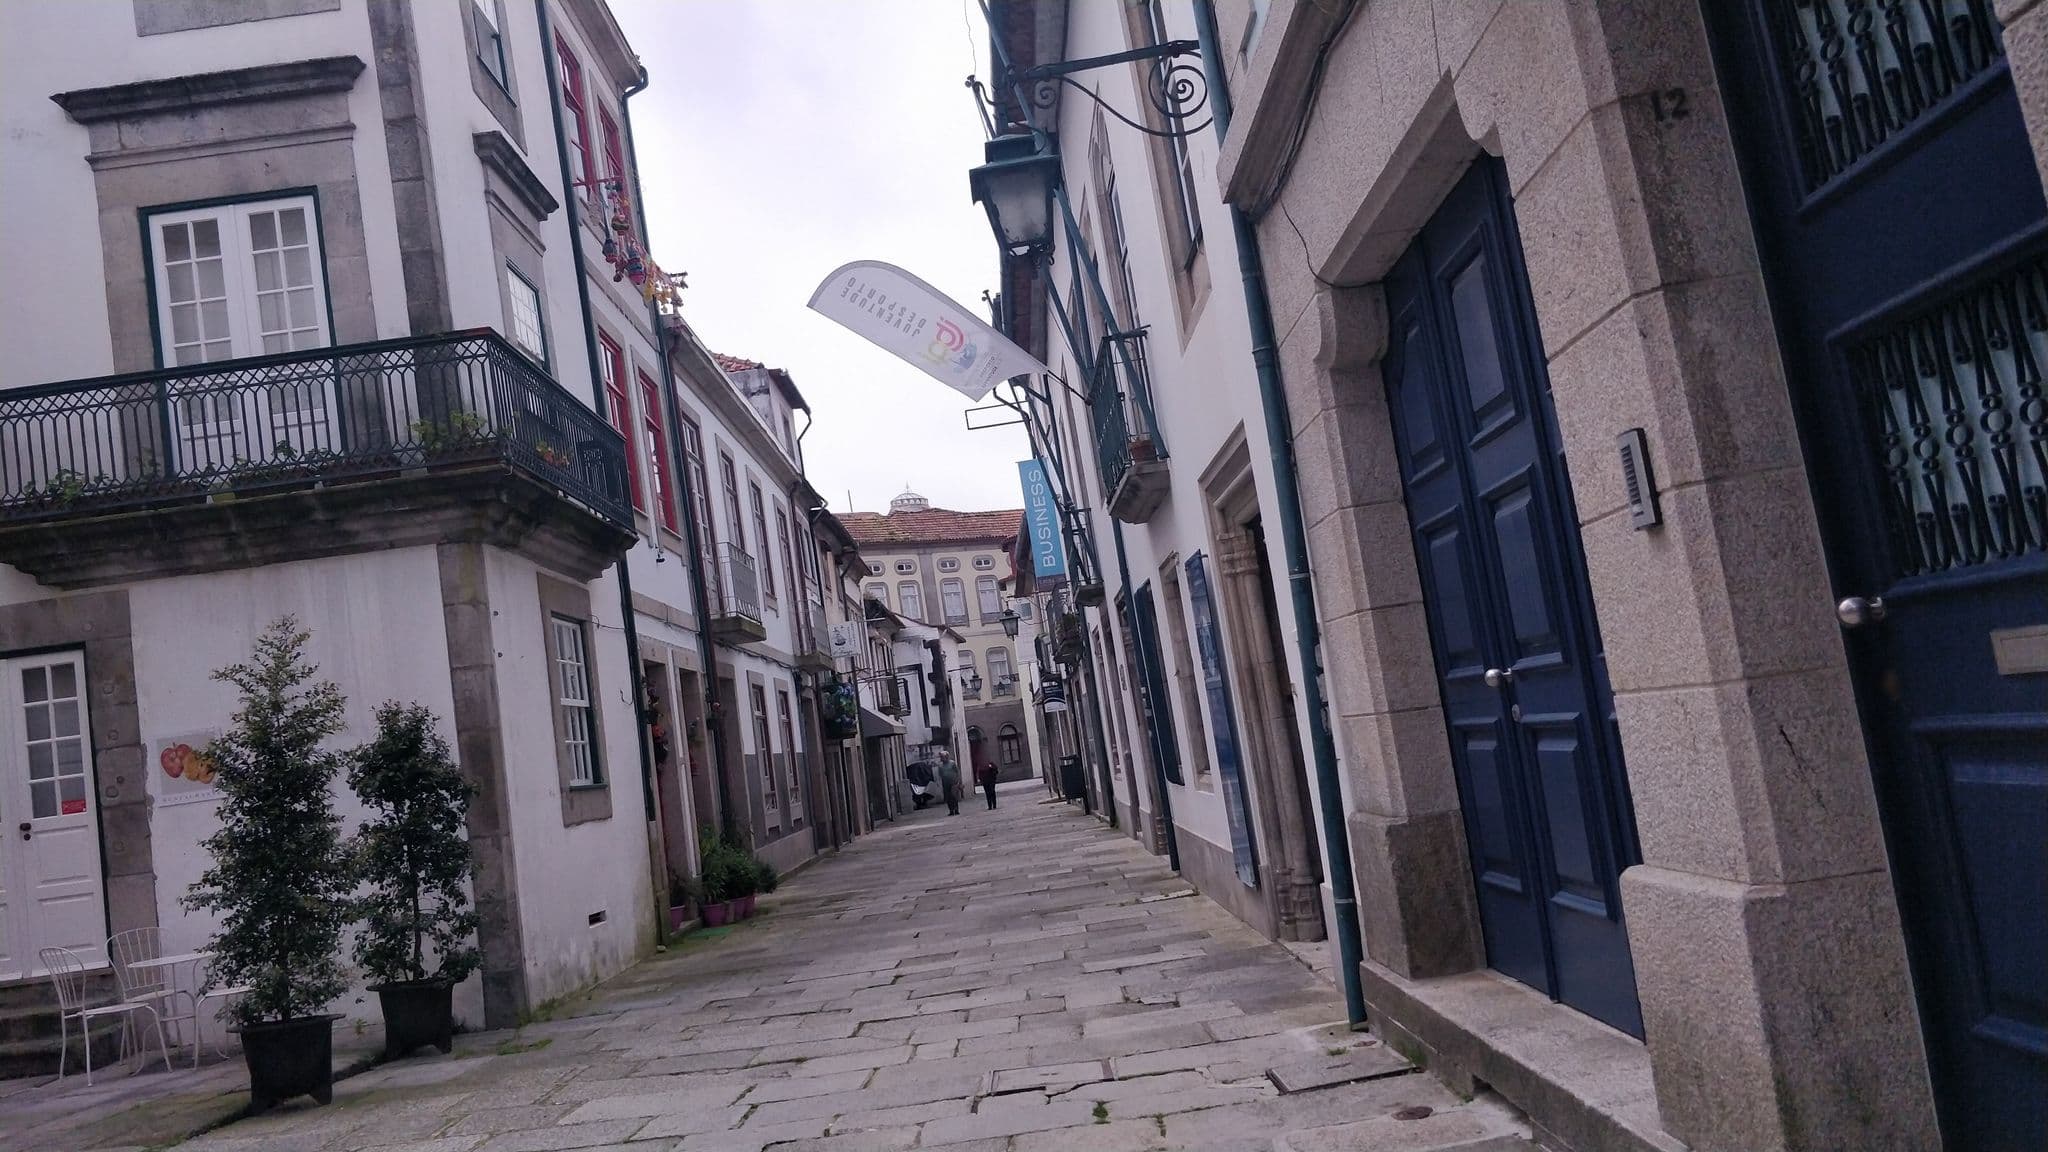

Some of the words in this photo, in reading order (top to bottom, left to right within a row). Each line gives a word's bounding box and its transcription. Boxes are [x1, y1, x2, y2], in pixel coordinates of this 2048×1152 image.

[1651, 88, 1690, 122] 12
[840, 287, 921, 337] JUVENTUDE
[847, 276, 927, 329] DESPORTO
[1028, 469, 1056, 567] BUSINESS
